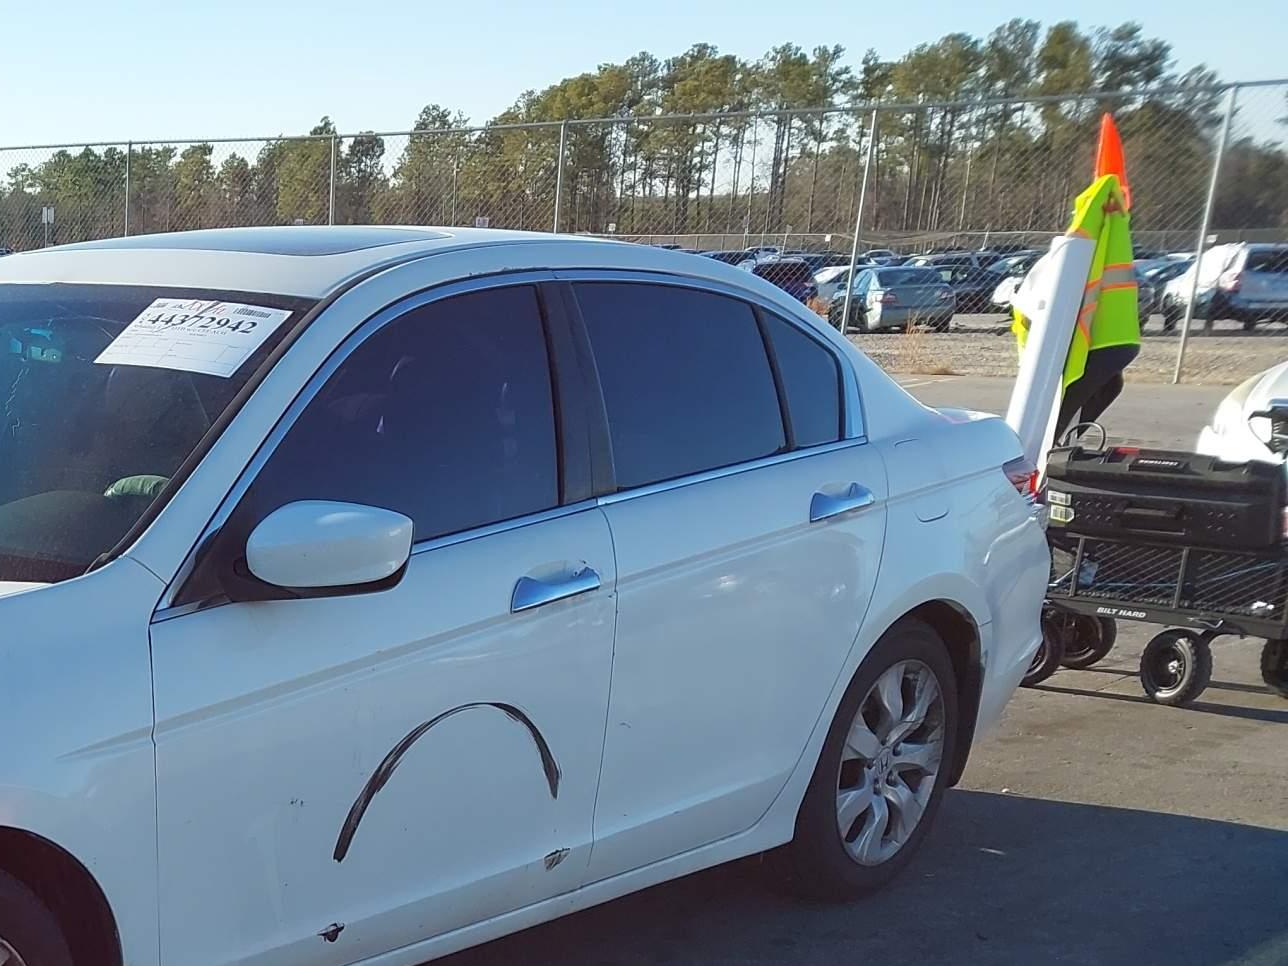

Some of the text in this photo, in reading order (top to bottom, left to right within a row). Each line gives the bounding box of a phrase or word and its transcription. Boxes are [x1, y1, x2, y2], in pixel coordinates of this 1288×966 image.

[147, 312, 258, 335] 44372942
[1096, 606, 1147, 619] BILT HARD
